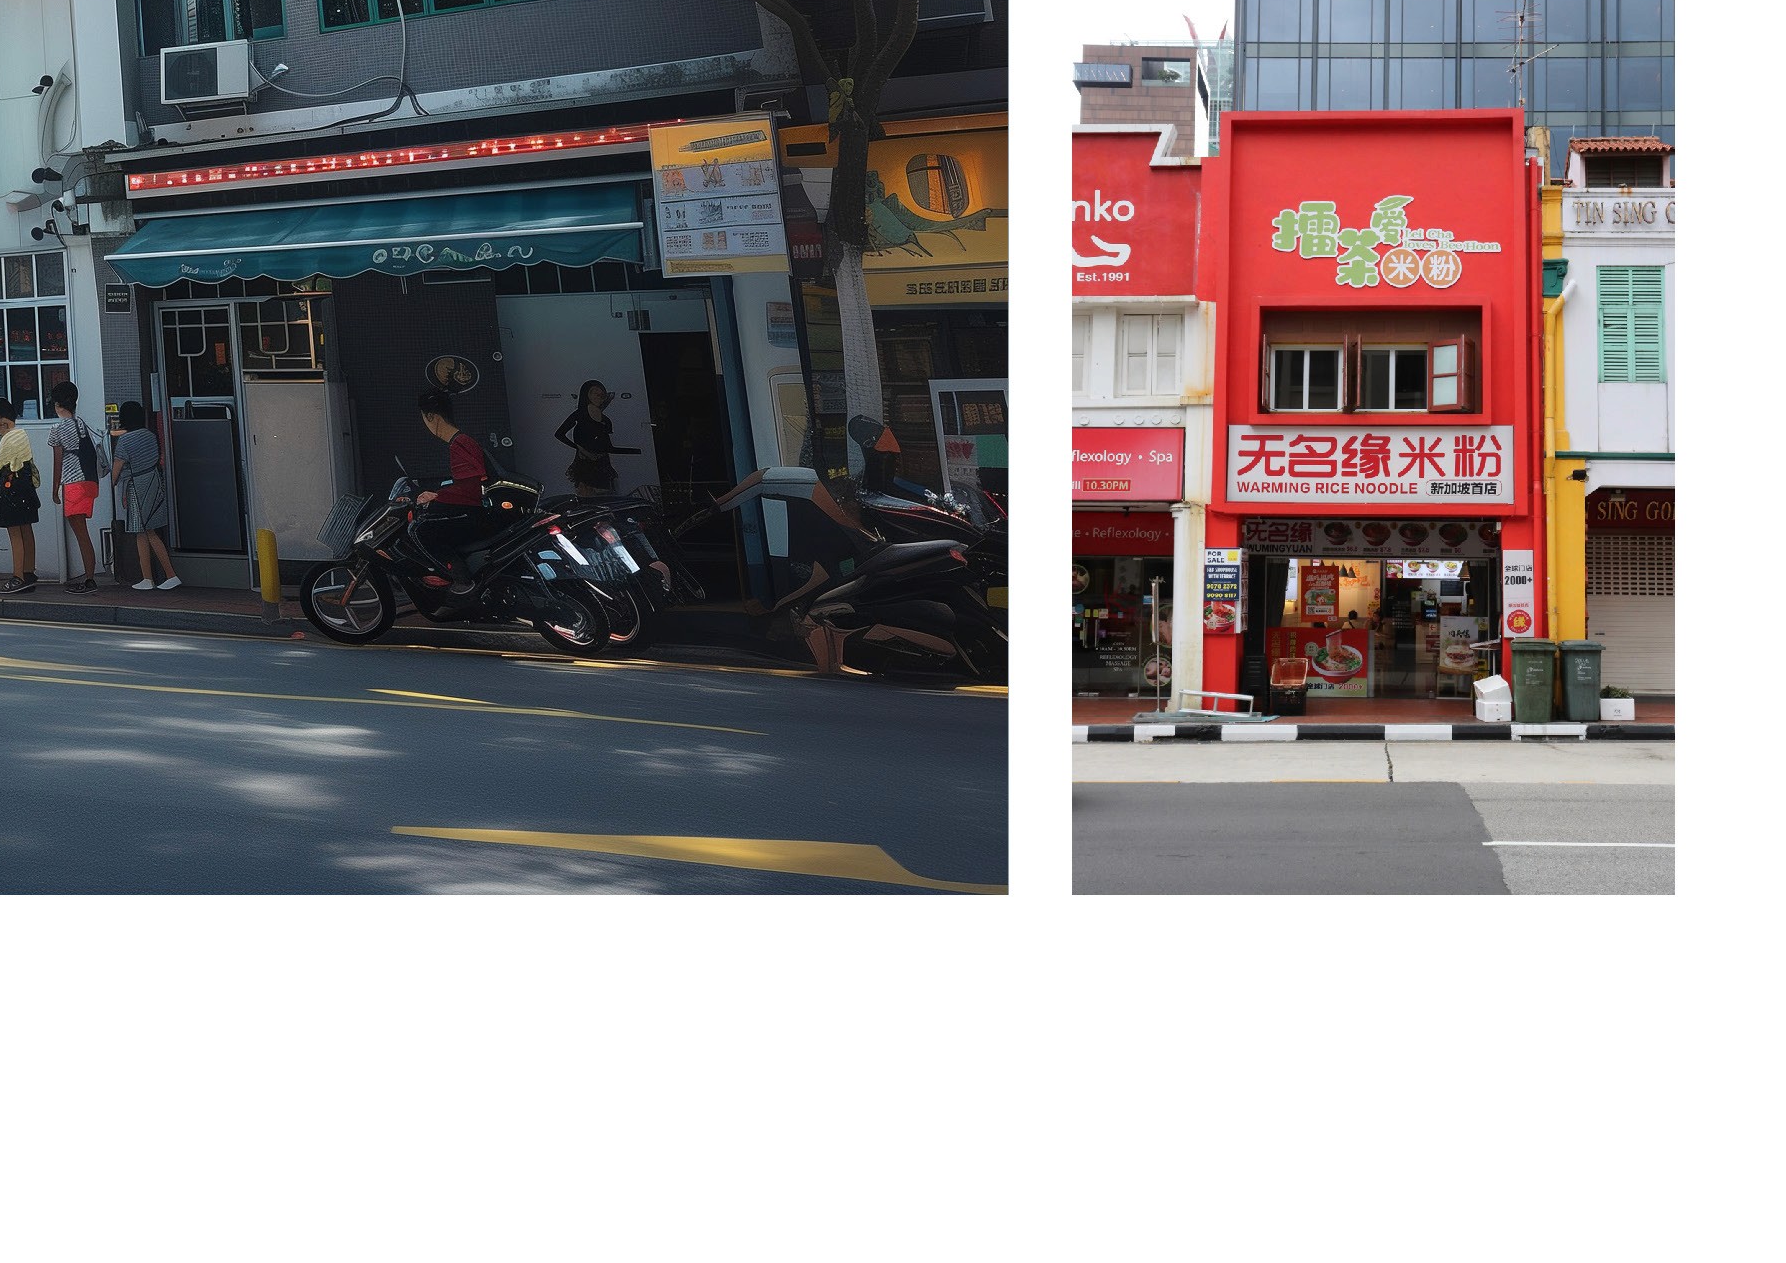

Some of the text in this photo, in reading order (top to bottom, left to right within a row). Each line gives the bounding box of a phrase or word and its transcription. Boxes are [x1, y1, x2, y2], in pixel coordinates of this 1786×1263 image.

[1573, 200, 1605, 225] TIN
[1612, 200, 1657, 225] SING
[1428, 229, 1454, 239] Cha
[1404, 240, 1435, 250] loves
[1076, 272, 1130, 282] Est.1991
[1148, 450, 1173, 466] Spa
[1236, 433, 1503, 479] 无名缘米粉
[1085, 480, 1129, 490] 10.30PM
[1237, 481, 1418, 495] WARMING RICE NOODLE
[1430, 480, 1497, 495] 新加坡首店
[1597, 500, 1638, 521] SING
[1645, 501, 1675, 521] GO
[1092, 526, 1162, 542] Reflexology
[1246, 521, 1312, 543] 无名缘
[1504, 575, 1533, 585] 2000+
